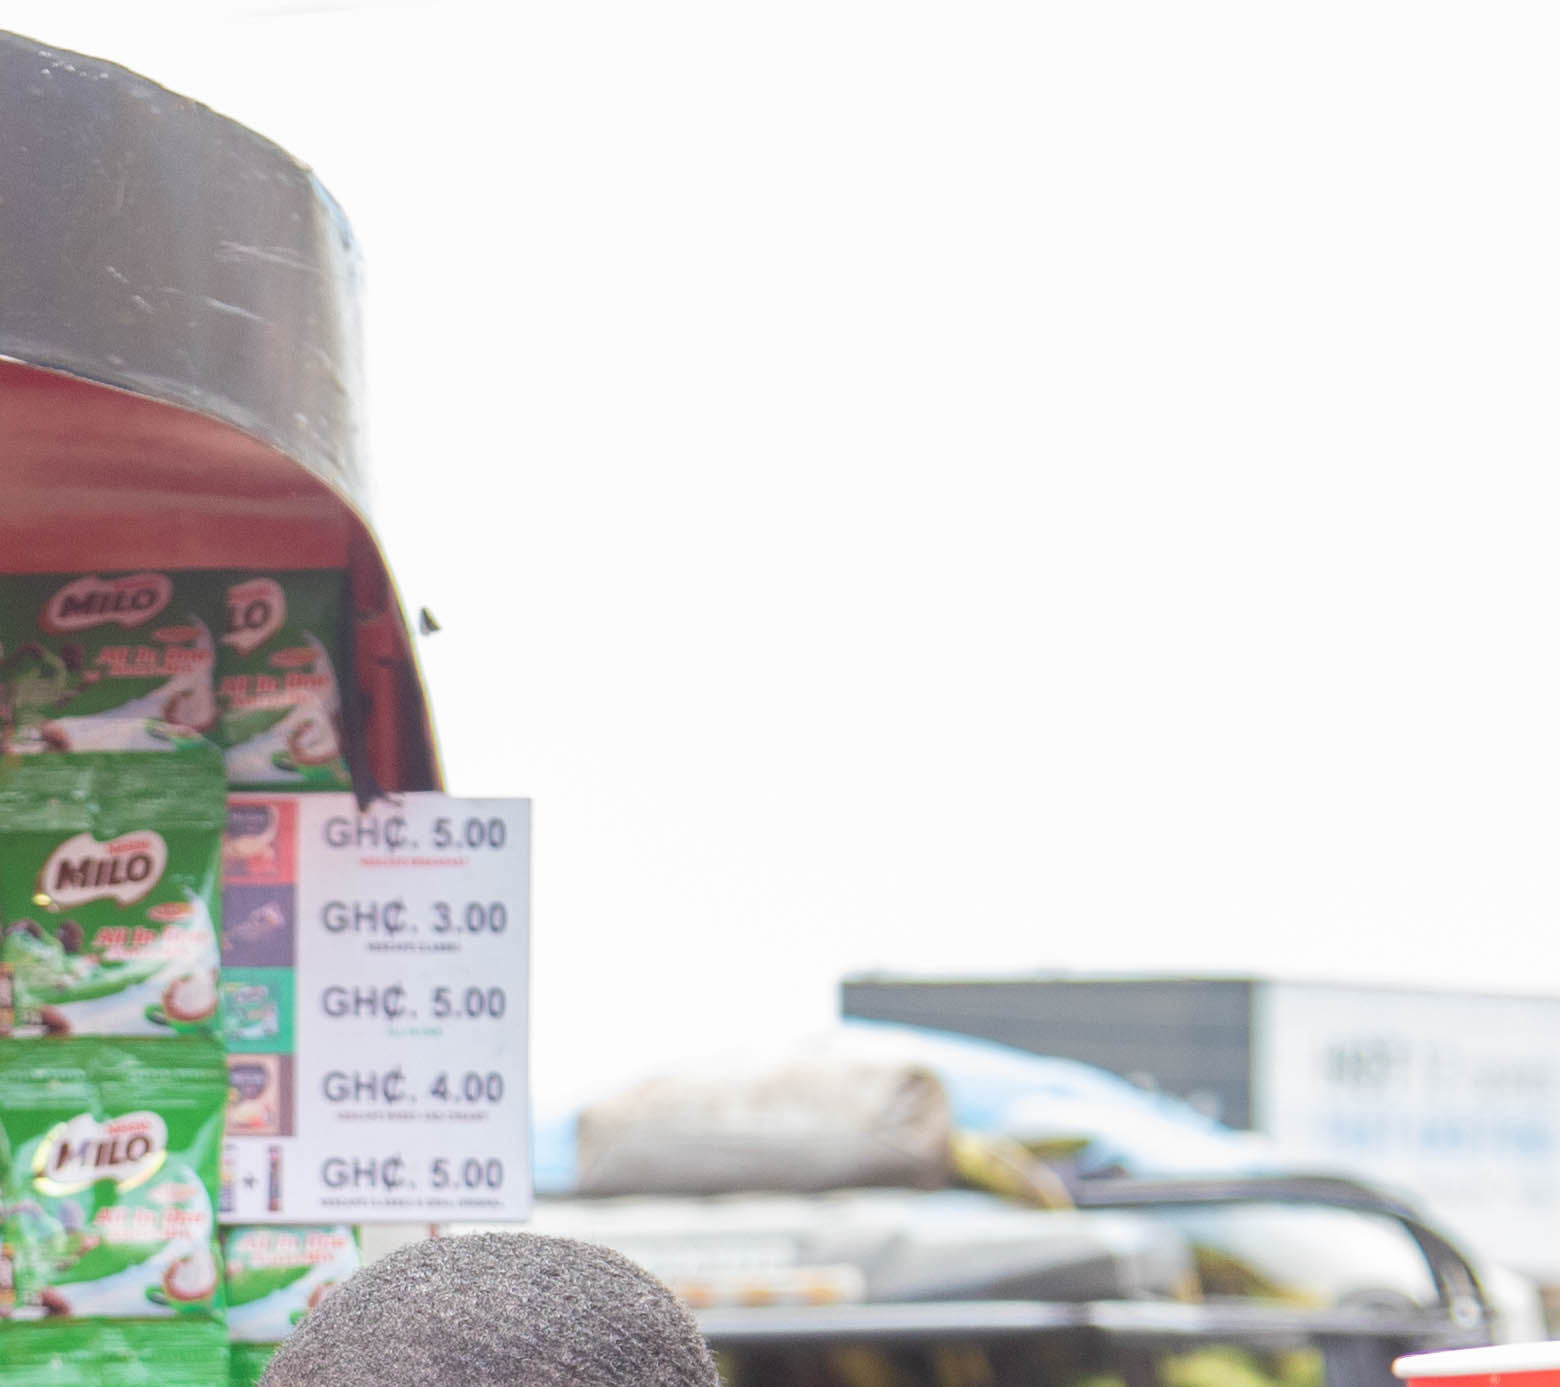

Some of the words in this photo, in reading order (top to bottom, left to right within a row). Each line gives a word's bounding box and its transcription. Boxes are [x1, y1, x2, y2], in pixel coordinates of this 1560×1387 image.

[433, 817, 507, 849] 5.00
[55, 855, 152, 891] MILO
[432, 901, 507, 933] 3.00
[432, 985, 507, 1018] 5.00
[430, 1070, 504, 1102] 4.00
[55, 1135, 151, 1170] MILO
[430, 1157, 504, 1189] 5.00
